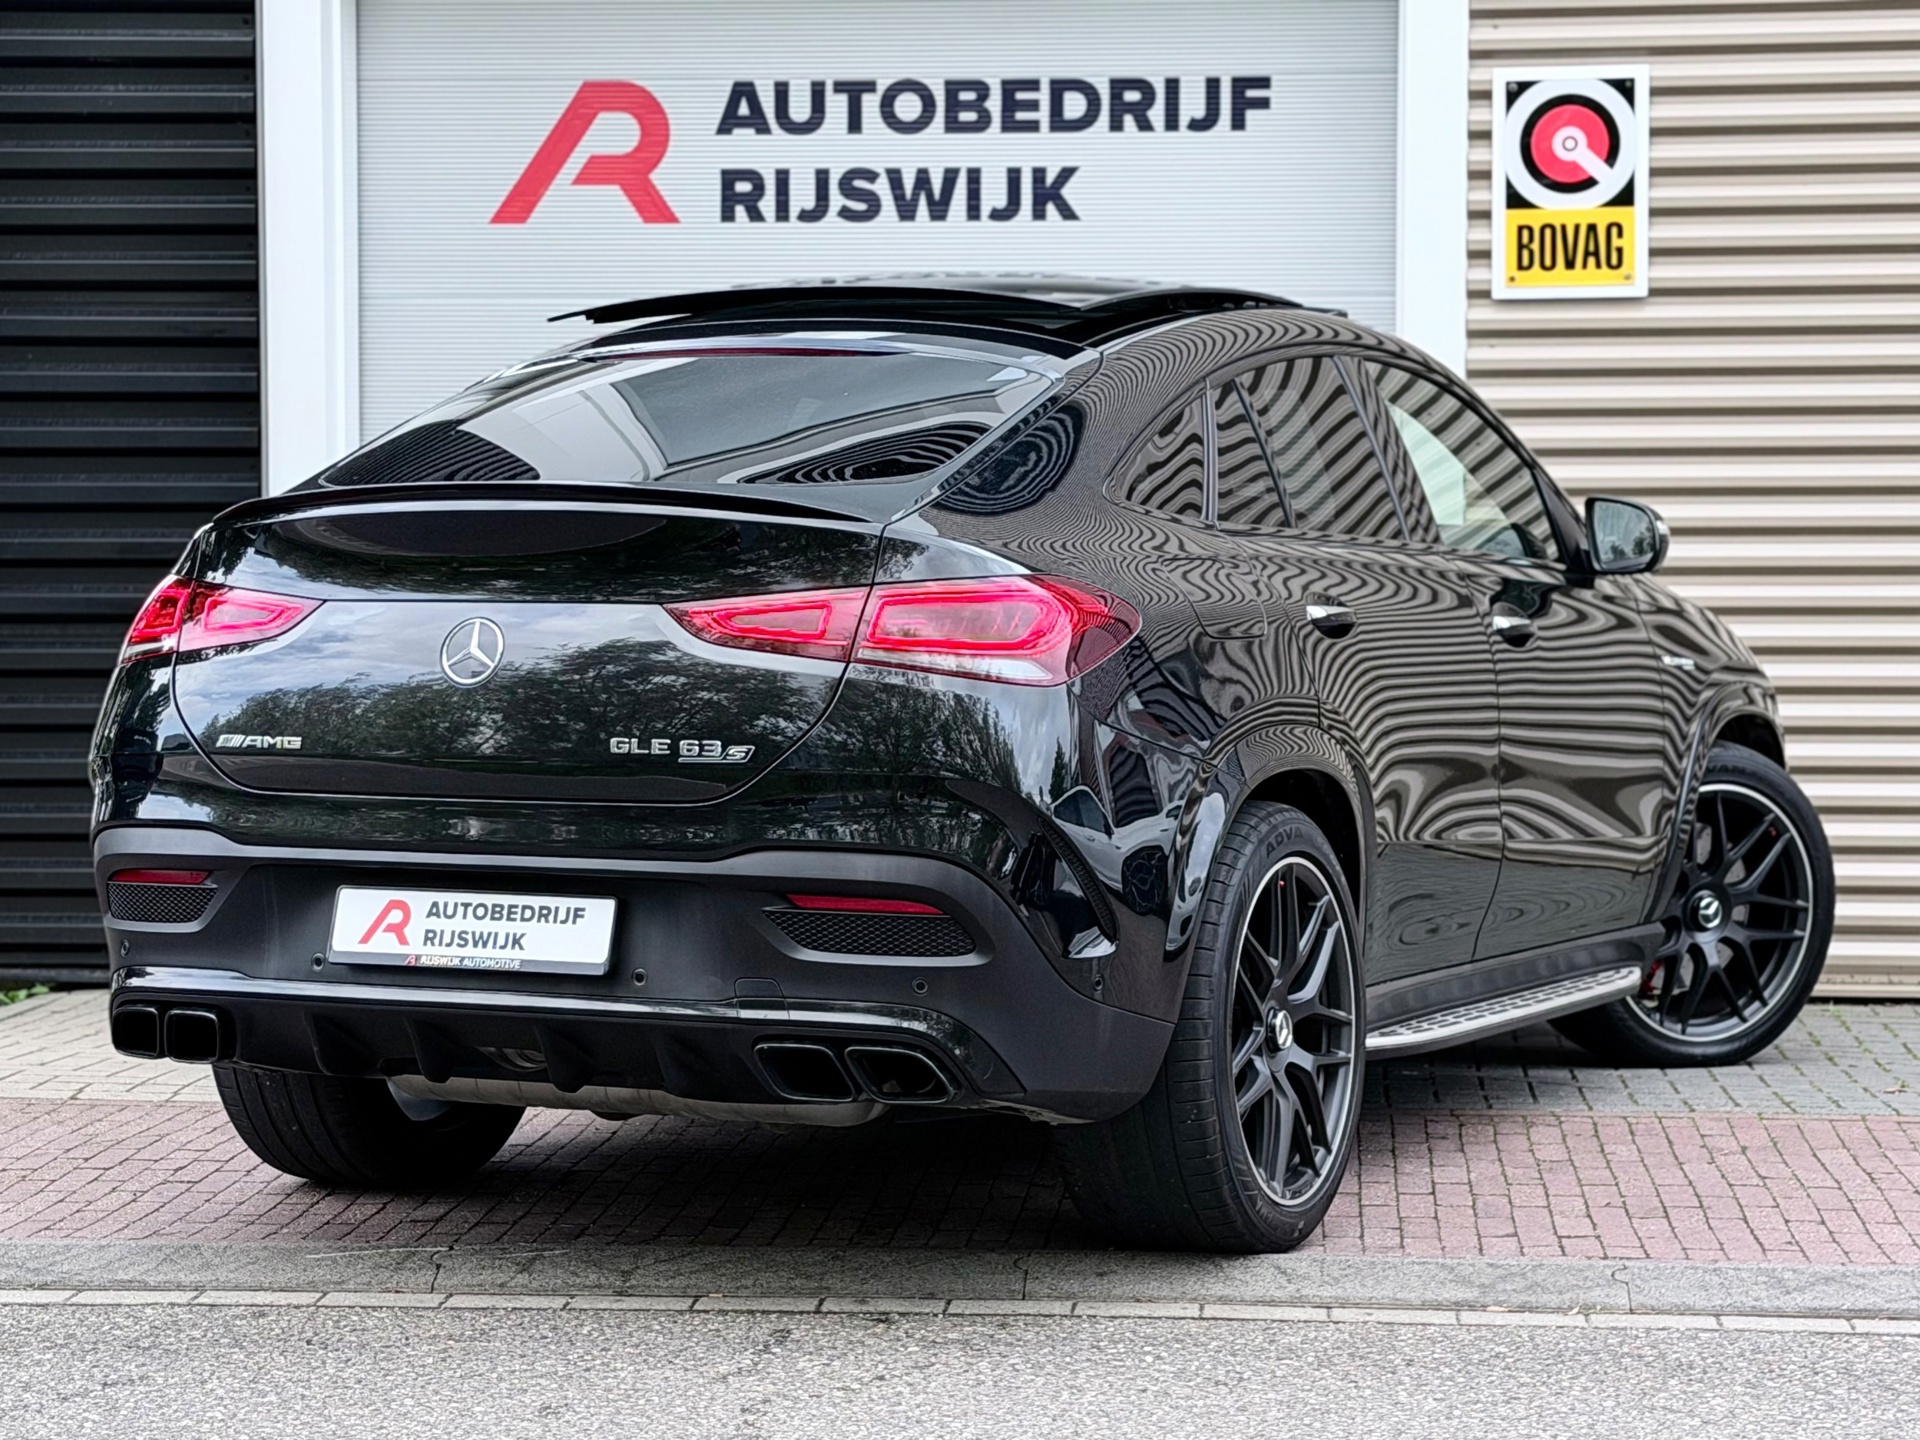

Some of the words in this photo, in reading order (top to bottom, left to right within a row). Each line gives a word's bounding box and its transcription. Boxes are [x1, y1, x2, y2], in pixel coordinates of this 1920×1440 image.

[715, 75, 1273, 135] AUTOBEDRIJF
[719, 166, 1081, 224] RIJSWIJK
[1516, 221, 1624, 272] BOVAG
[241, 735, 303, 750] AMG
[609, 737, 671, 755] GLE
[1265, 825, 1306, 859] ADVA
[425, 900, 587, 926] AUTOBEDRIJF
[422, 928, 527, 952] RIJSWIJK
[419, 955, 462, 967] RIJSWIJK
[463, 957, 522, 970] AUTOMOTIVE
